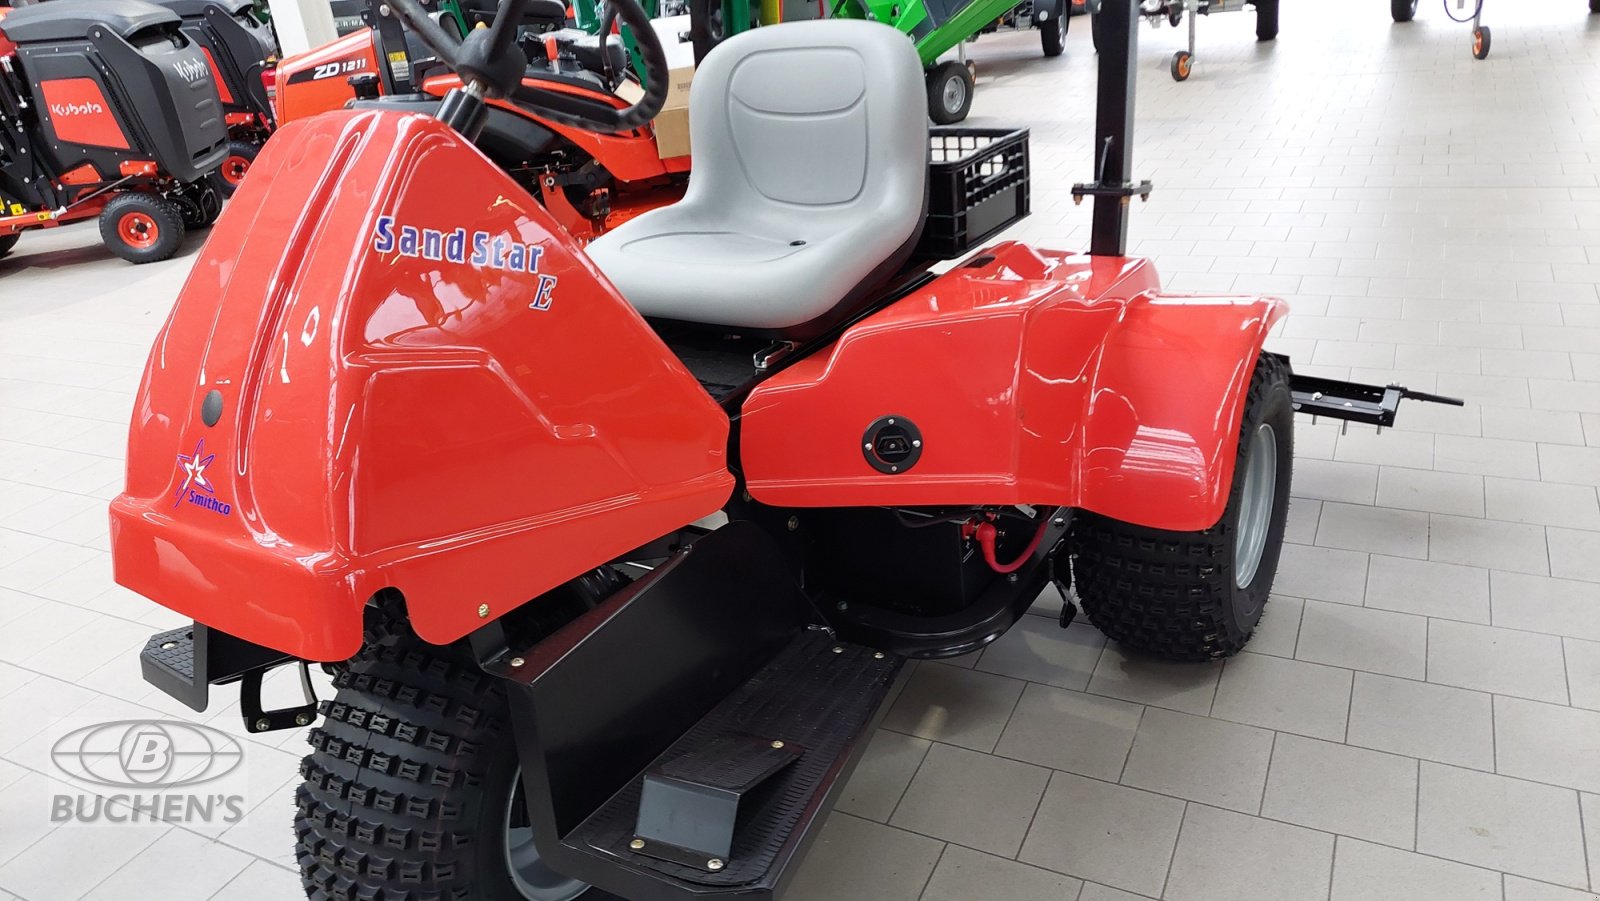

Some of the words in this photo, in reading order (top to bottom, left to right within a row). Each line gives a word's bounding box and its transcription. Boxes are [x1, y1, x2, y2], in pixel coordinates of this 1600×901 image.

[173, 57, 208, 82] Kubota
[313, 63, 340, 80] ZD
[342, 58, 367, 73] 1211
[51, 101, 102, 117] Kubota
[529, 273, 558, 312] E
[188, 489, 231, 516] Smithco
